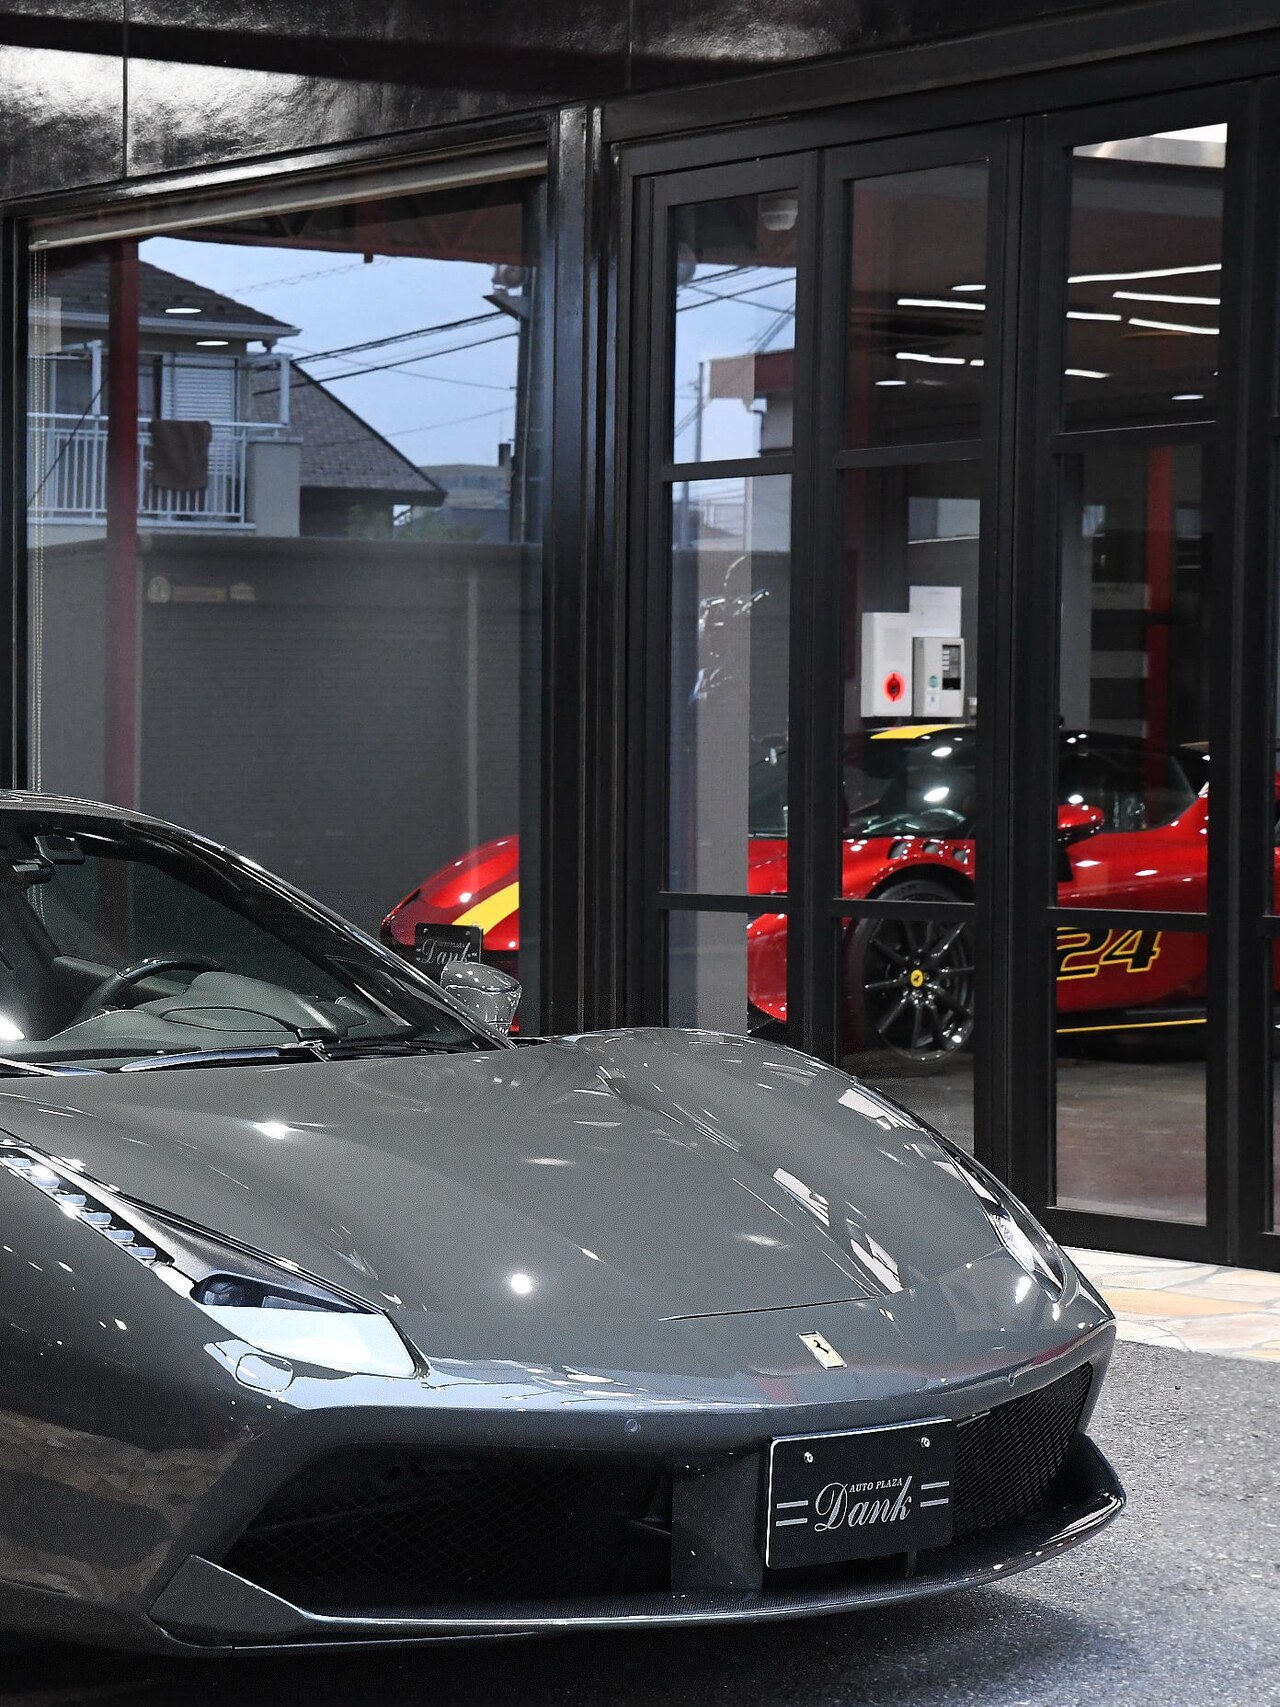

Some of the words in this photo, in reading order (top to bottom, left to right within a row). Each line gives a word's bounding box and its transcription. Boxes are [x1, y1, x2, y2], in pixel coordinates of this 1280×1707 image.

[1056, 926, 1163, 981] 24
[814, 1475, 913, 1532] Dank
[849, 1481, 874, 1493] AUTO
[876, 1477, 903, 1490] PLAZA
